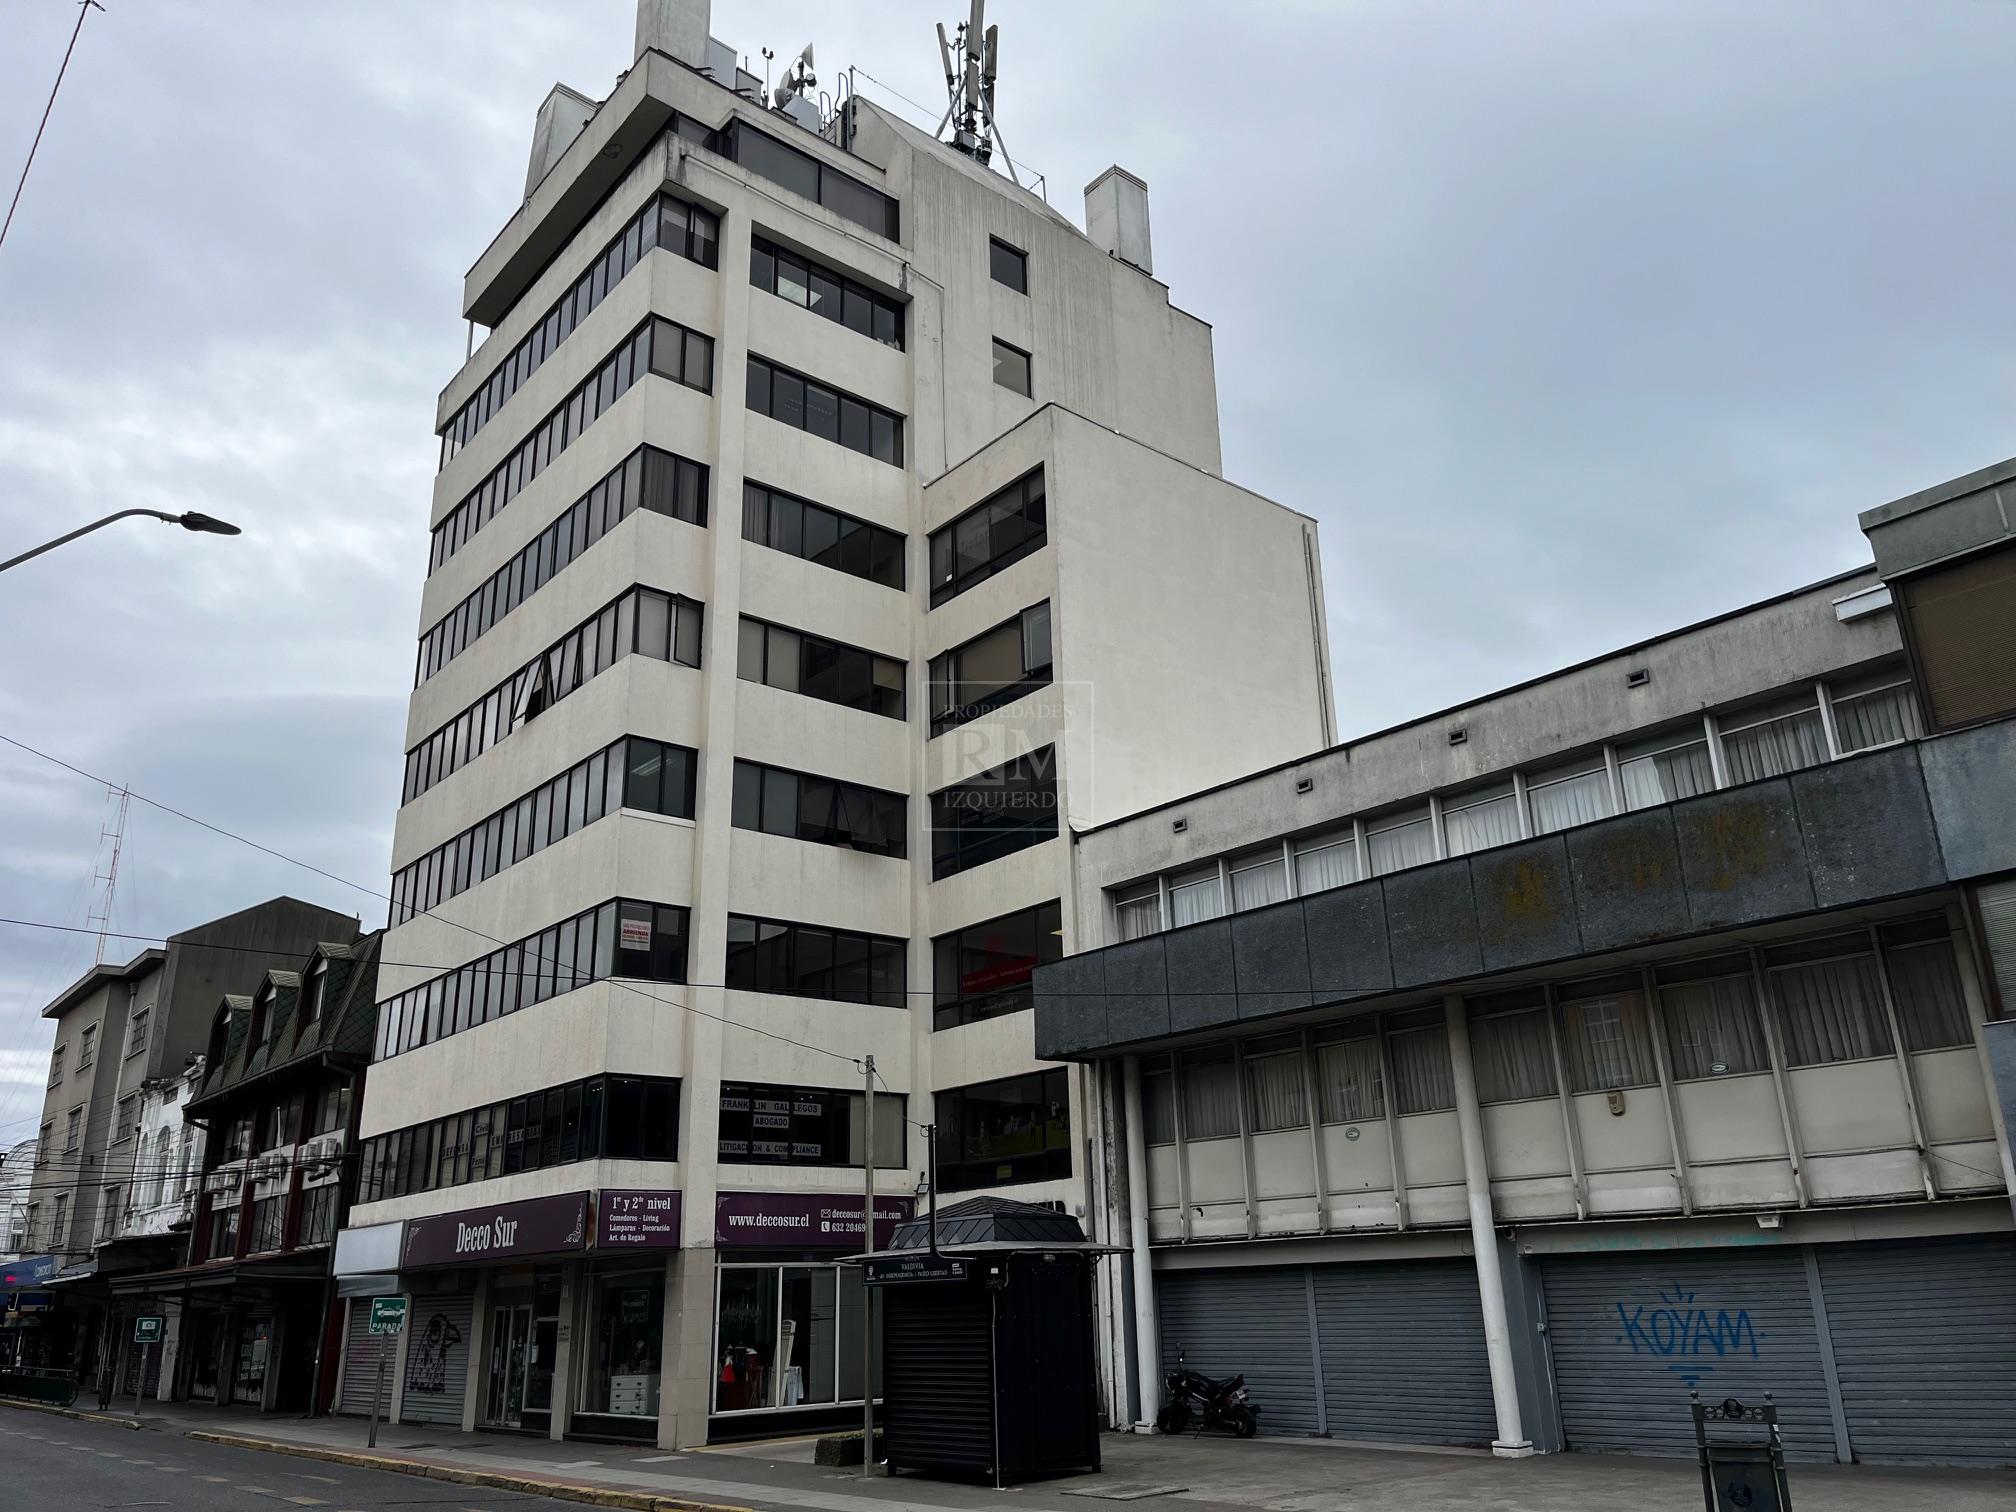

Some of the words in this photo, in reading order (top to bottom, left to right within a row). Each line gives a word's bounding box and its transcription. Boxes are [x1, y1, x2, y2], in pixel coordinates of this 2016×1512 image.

[755, 1117, 788, 1126] ABOGADO
[623, 1199, 630, 1212] y
[647, 1197, 671, 1210] nivel
[609, 1214, 638, 1222] Comedores
[642, 1214, 660, 1223] Living
[831, 1208, 902, 1220] deccosur@mail.com
[728, 1213, 810, 1228] www.deccosur.cl
[609, 1223, 637, 1233] Lámparas
[642, 1223, 671, 1232] Decoración
[455, 1222, 491, 1253] Decco
[493, 1215, 518, 1249] Sur
[620, 1233, 627, 1241] de
[627, 1233, 646, 1243] Regalo
[900, 1262, 925, 1271] VALDIVIA
[1617, 1301, 1760, 1359] KOYAM
